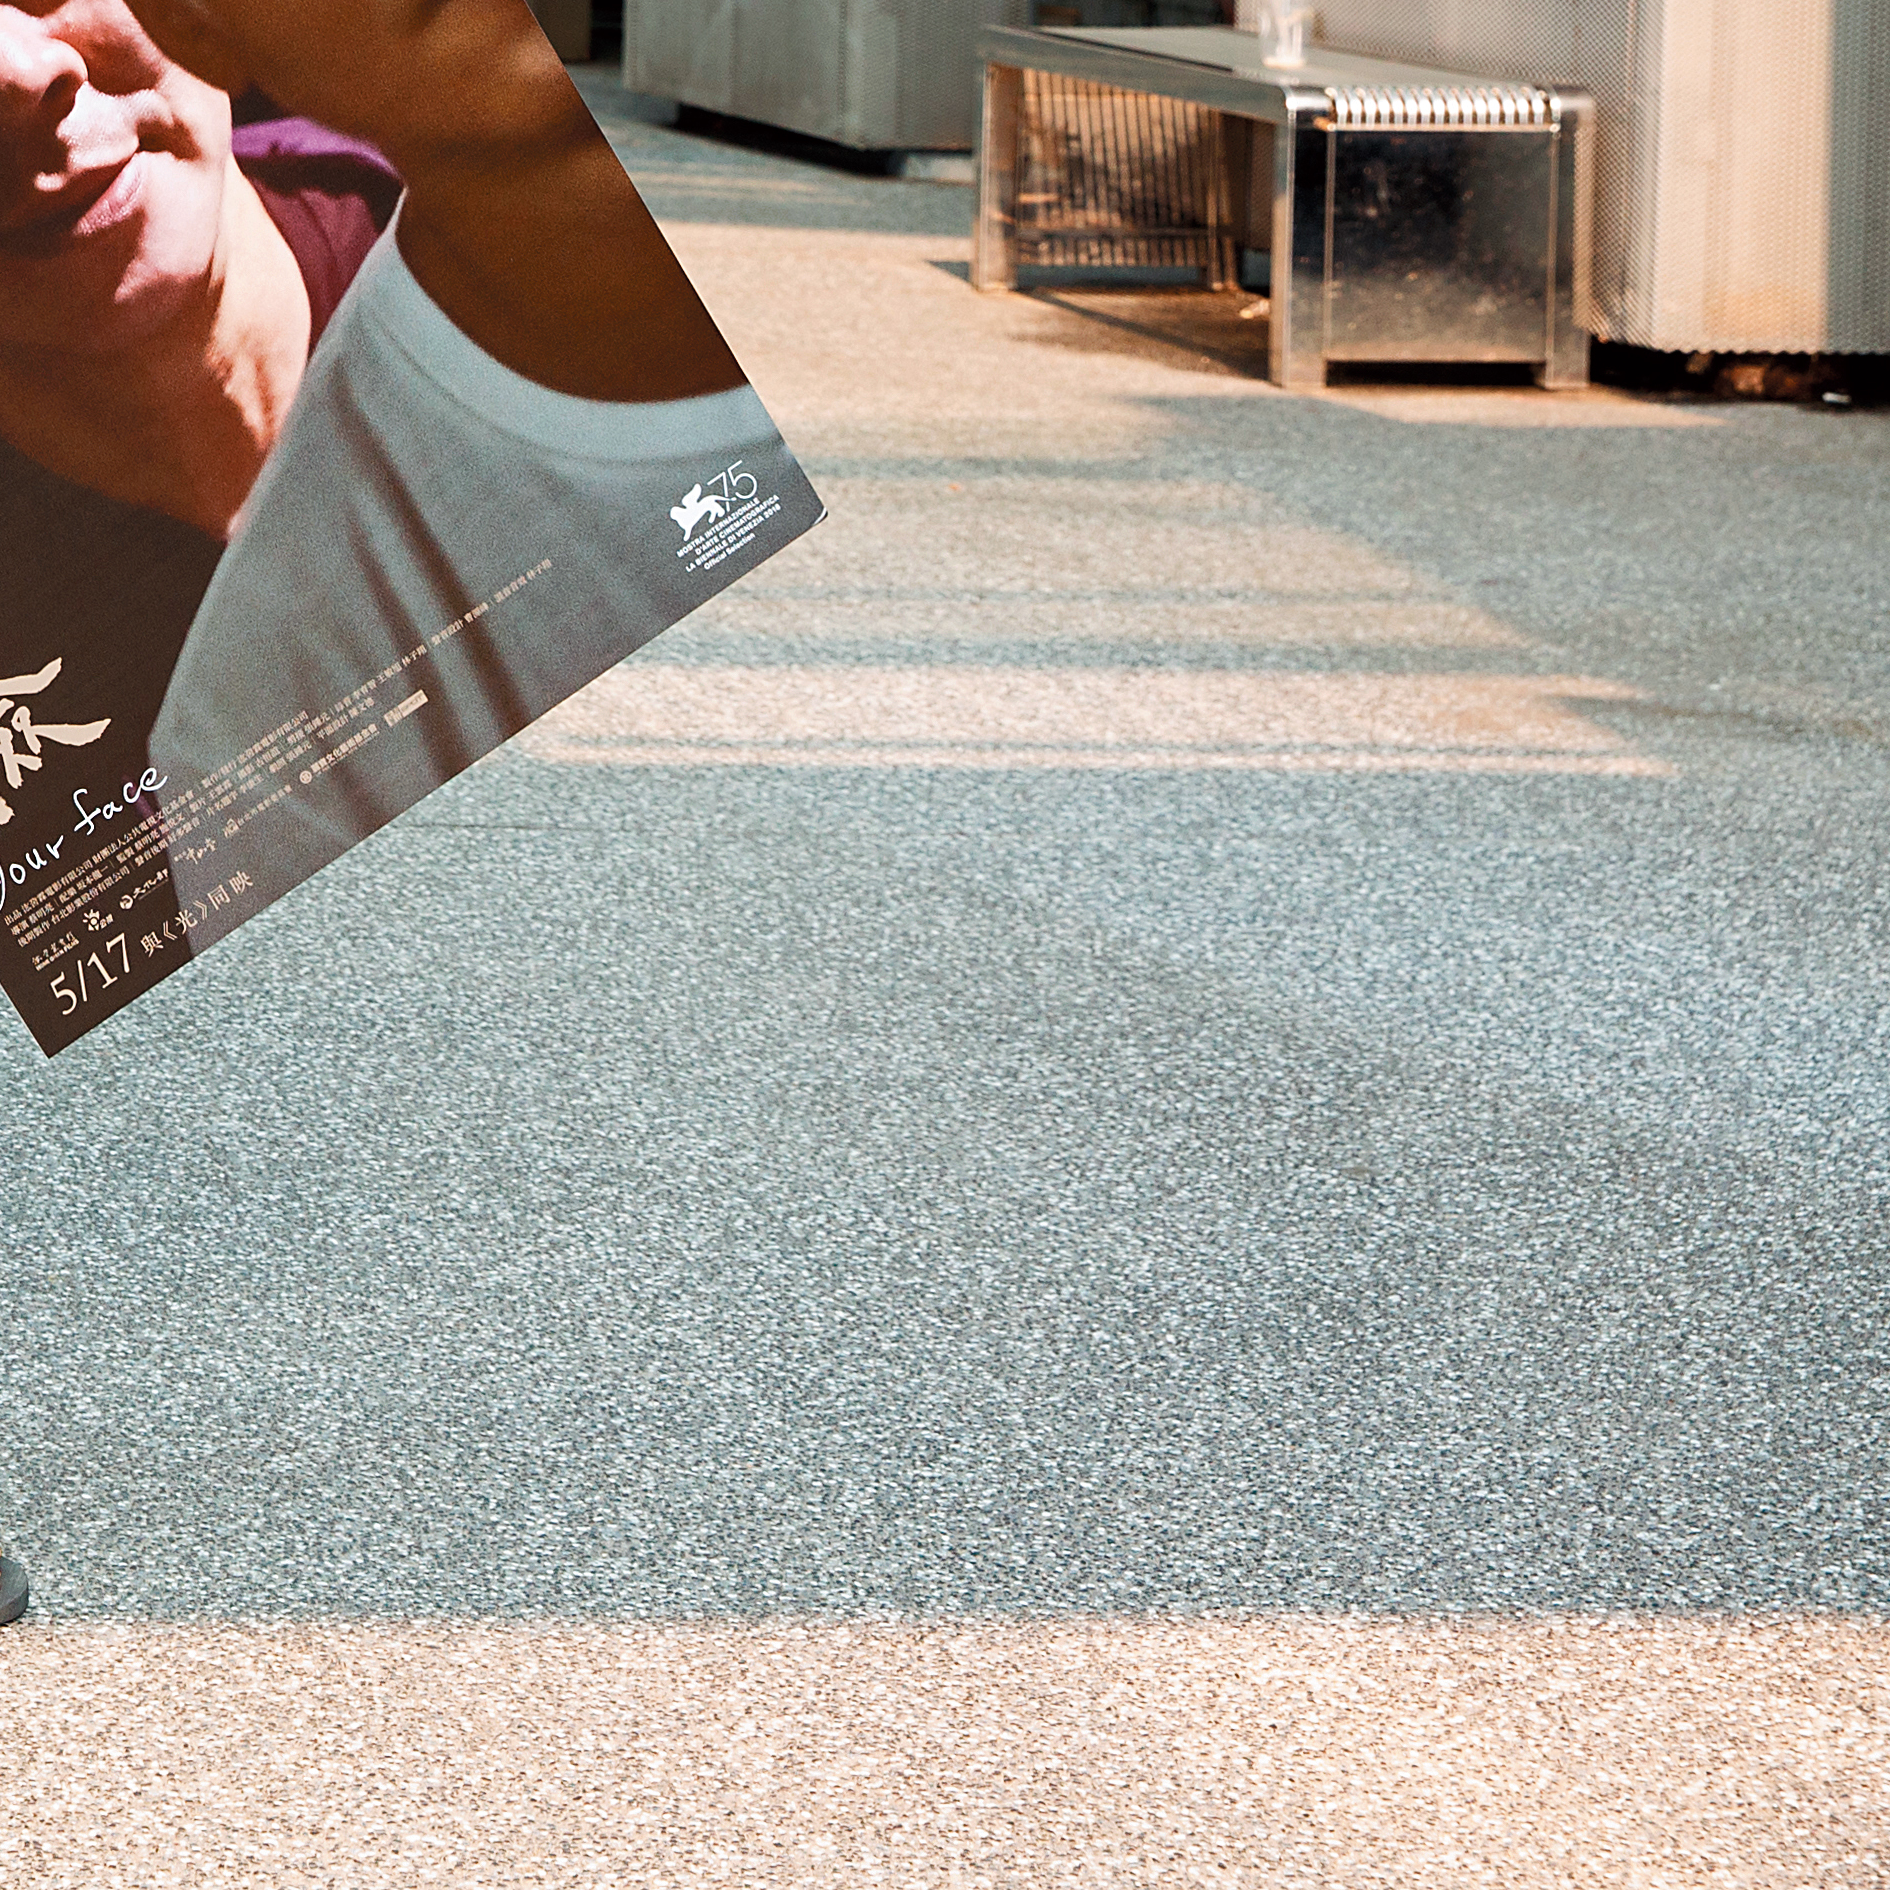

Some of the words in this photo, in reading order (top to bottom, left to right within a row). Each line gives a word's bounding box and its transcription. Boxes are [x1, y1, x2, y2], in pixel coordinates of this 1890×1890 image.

[707, 460, 758, 512] 75
[73, 747, 168, 835] face
[50, 932, 129, 1014] 5/17
